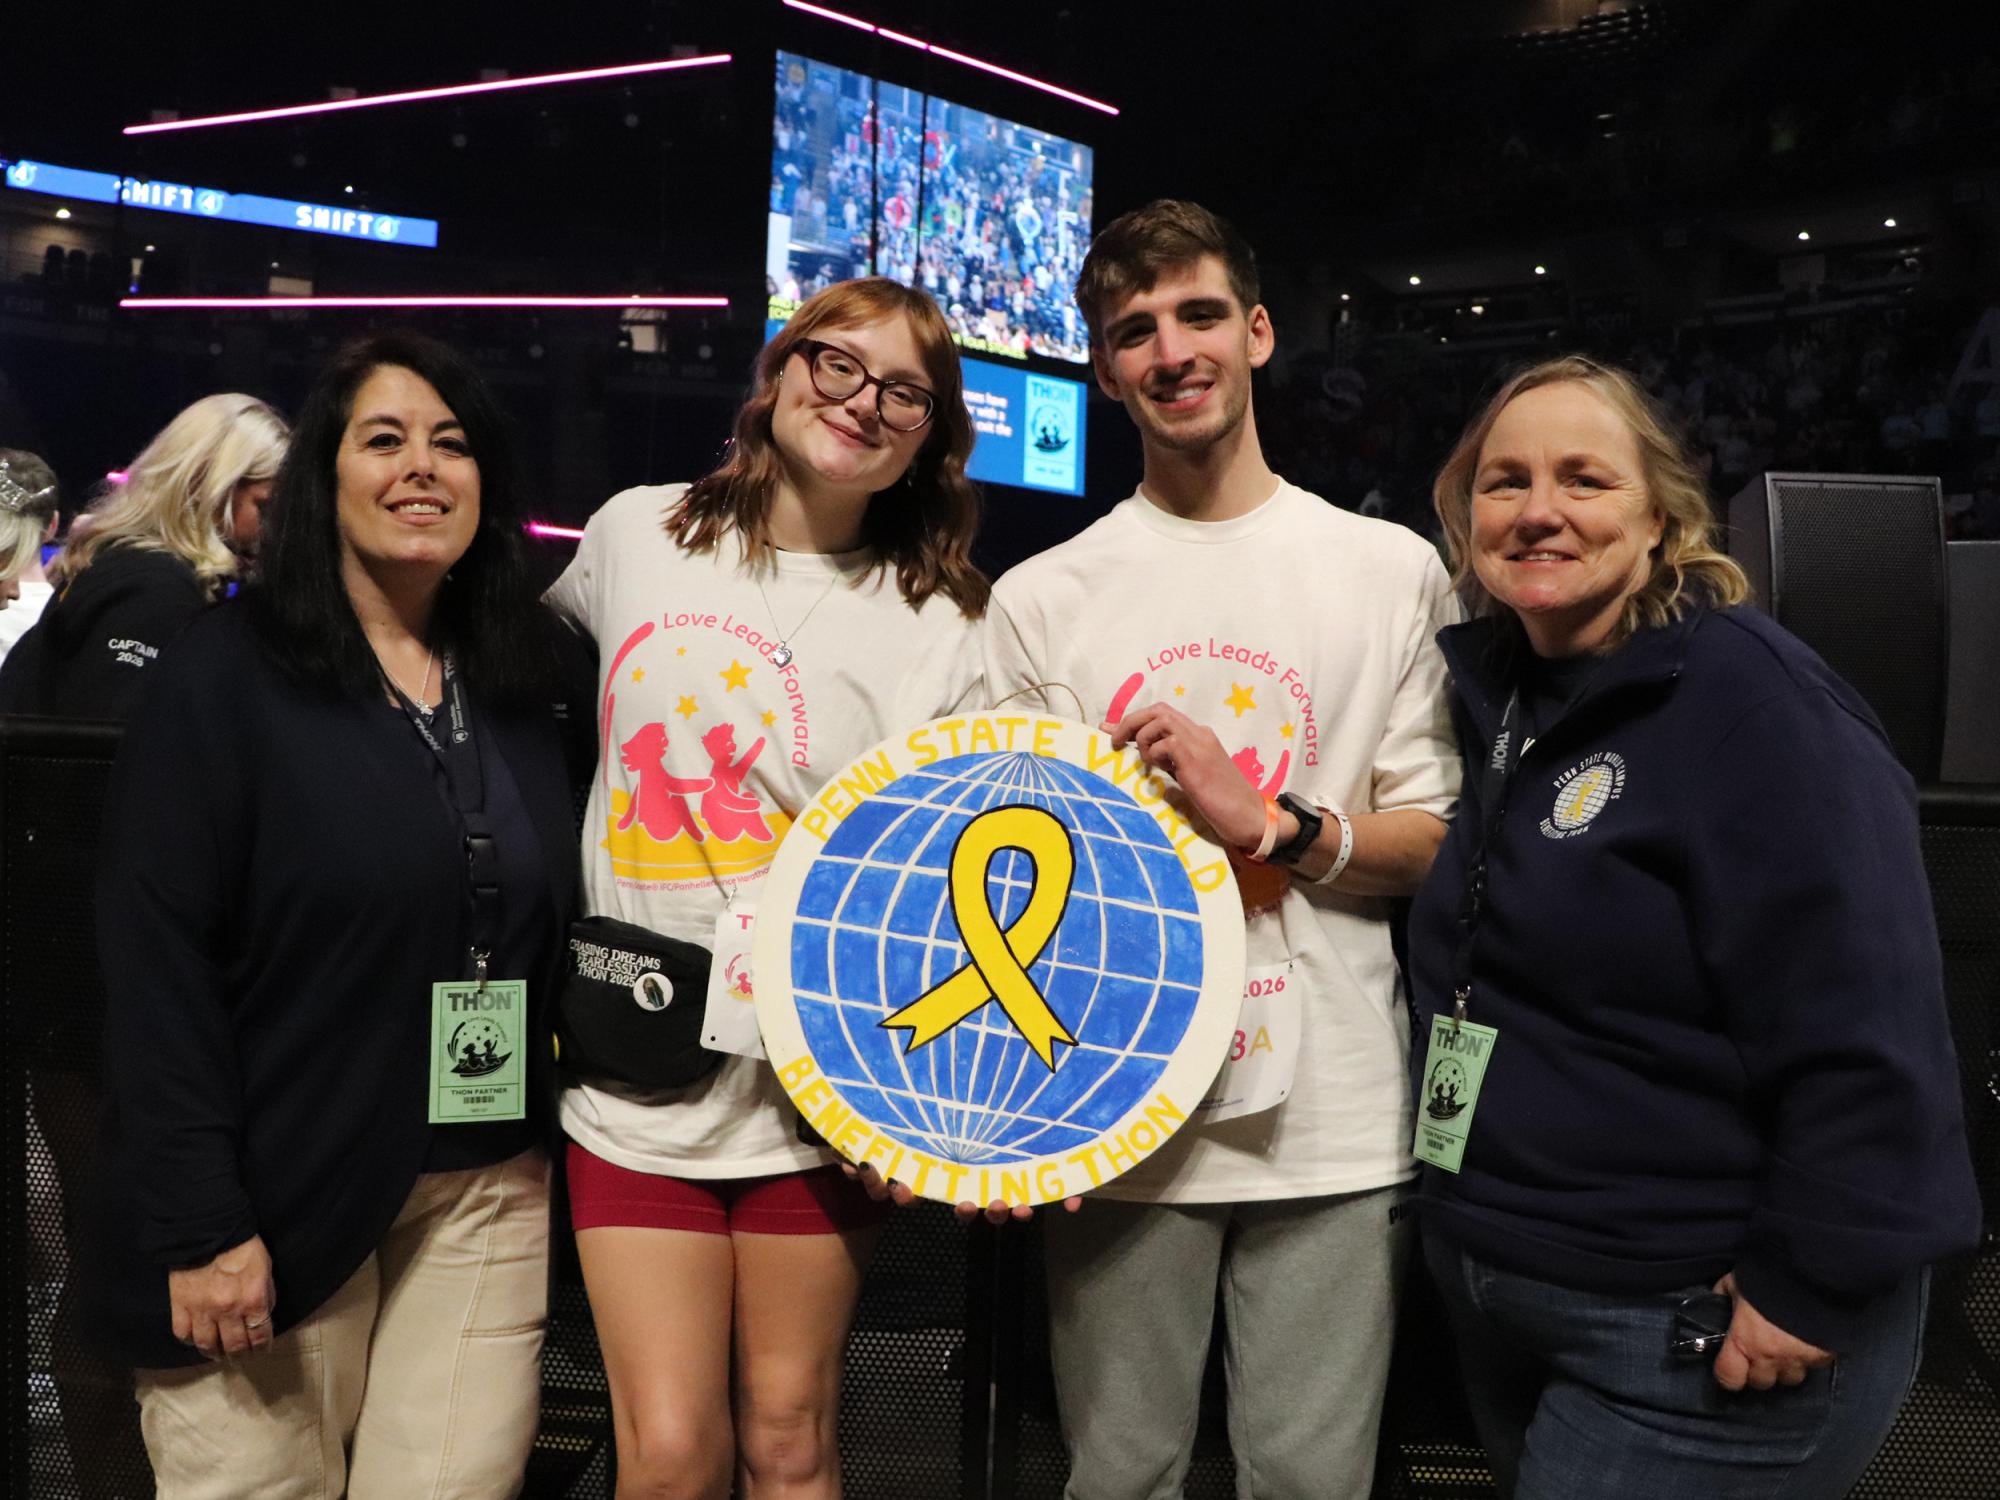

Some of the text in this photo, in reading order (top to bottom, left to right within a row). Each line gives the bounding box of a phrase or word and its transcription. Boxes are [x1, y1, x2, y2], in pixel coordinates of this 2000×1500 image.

[296, 204, 374, 235] SHIFT
[108, 638, 160, 659] CAPTAIN
[663, 612, 811, 769] Love Leads Forward
[1146, 637, 1319, 767] Love Leads Forward
[1491, 731, 1510, 770] THON
[1553, 766, 1578, 789] PENN
[1579, 752, 1604, 771] STATE
[801, 716, 1229, 894] PENN STATE WORLD
[569, 938, 661, 970] CHASING DREAMS
[577, 952, 642, 977] FEARLESSLY
[578, 963, 636, 988] THON 2025
[1243, 976, 1286, 999] 026
[447, 990, 512, 1012] THON
[1435, 1026, 1485, 1058] THON
[451, 1087, 508, 1096] THON PARTNER
[776, 1053, 1190, 1202] BENEFITTING THON
